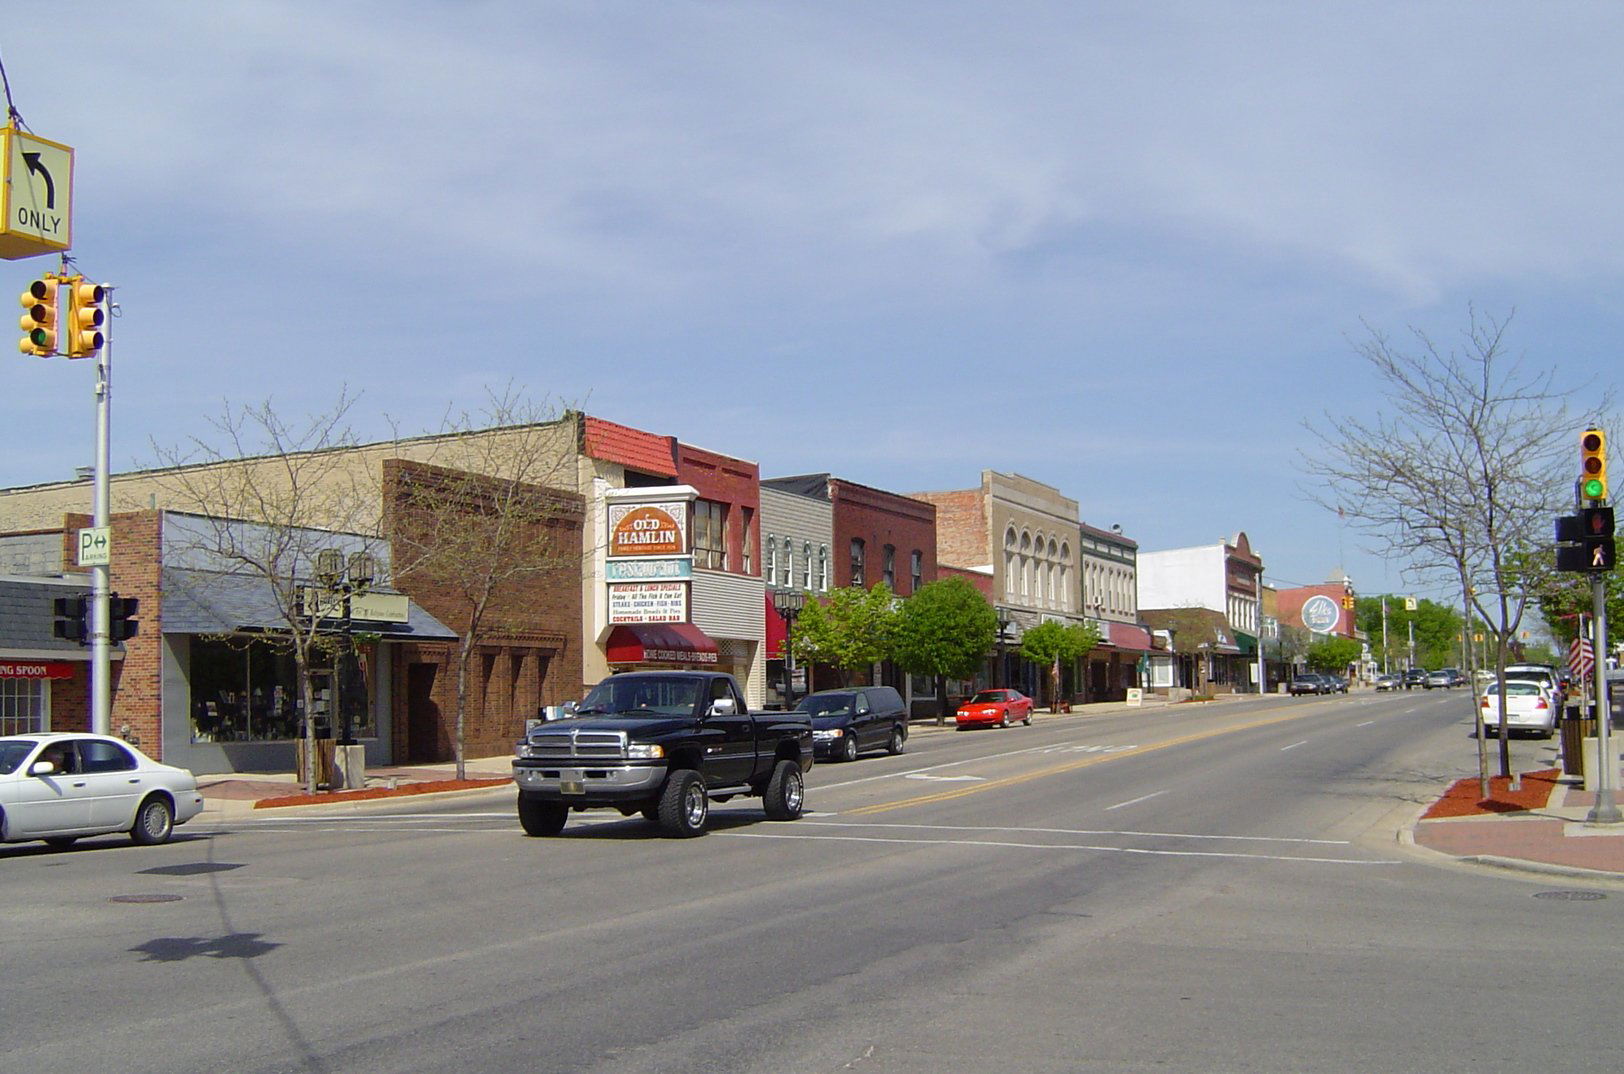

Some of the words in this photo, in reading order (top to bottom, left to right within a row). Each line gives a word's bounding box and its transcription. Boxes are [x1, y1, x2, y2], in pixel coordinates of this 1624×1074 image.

[18, 207, 61, 234] ONLY
[633, 516, 660, 530] OLD
[618, 531, 676, 544] HAMLIN
[661, 583, 681, 591] SPECIALS
[658, 650, 676, 660] COOKED
[16, 666, 47, 675] SPOON
